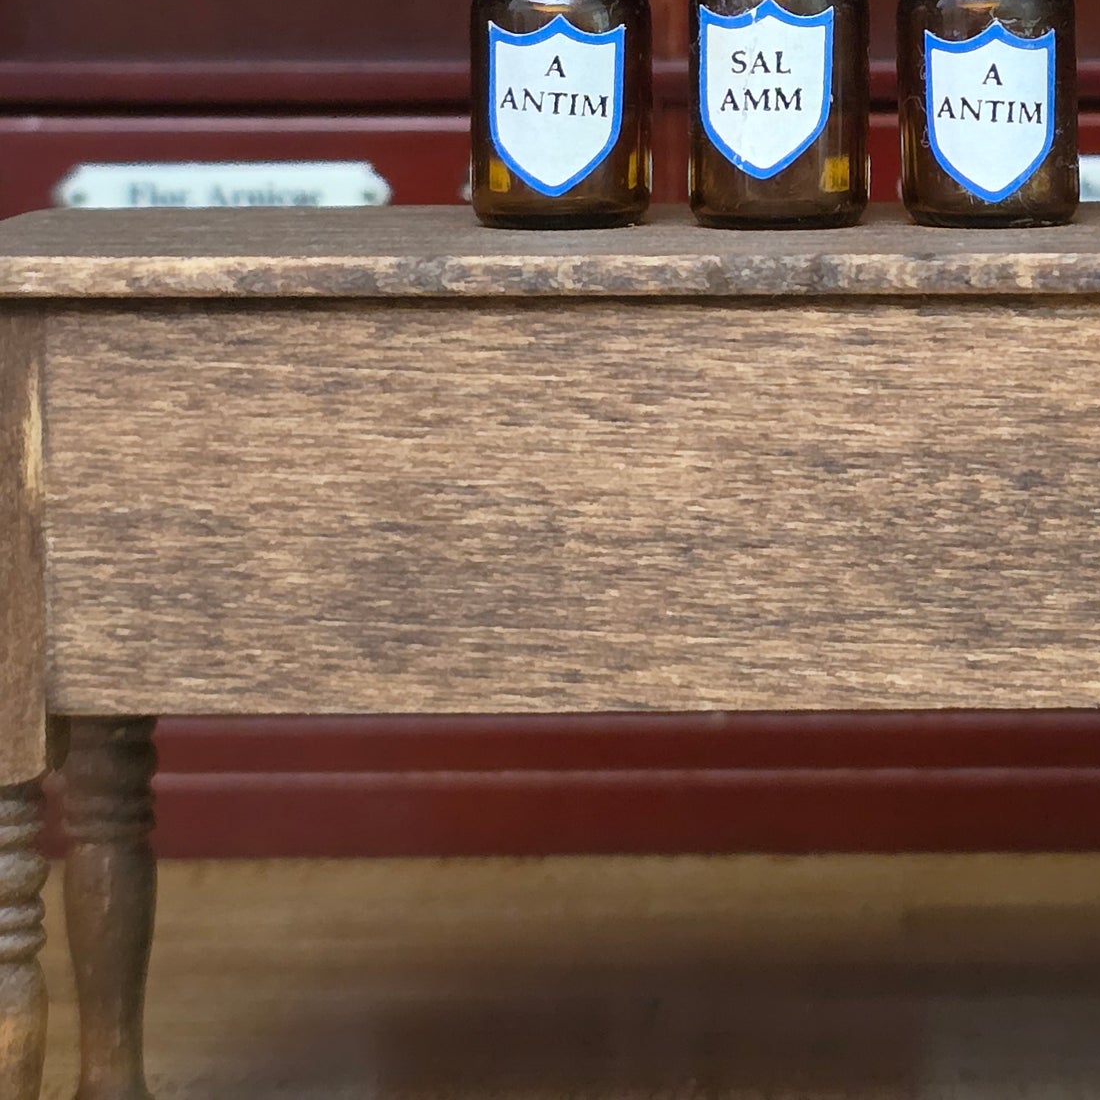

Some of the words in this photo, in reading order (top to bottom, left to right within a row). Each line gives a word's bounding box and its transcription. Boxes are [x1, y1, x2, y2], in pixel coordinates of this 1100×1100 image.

[545, 54, 567, 78] A
[731, 50, 792, 75] SAL
[982, 63, 1004, 87] A
[499, 86, 610, 119] ANTIM
[719, 87, 803, 113] AMM
[936, 95, 1043, 125] ANTIM
